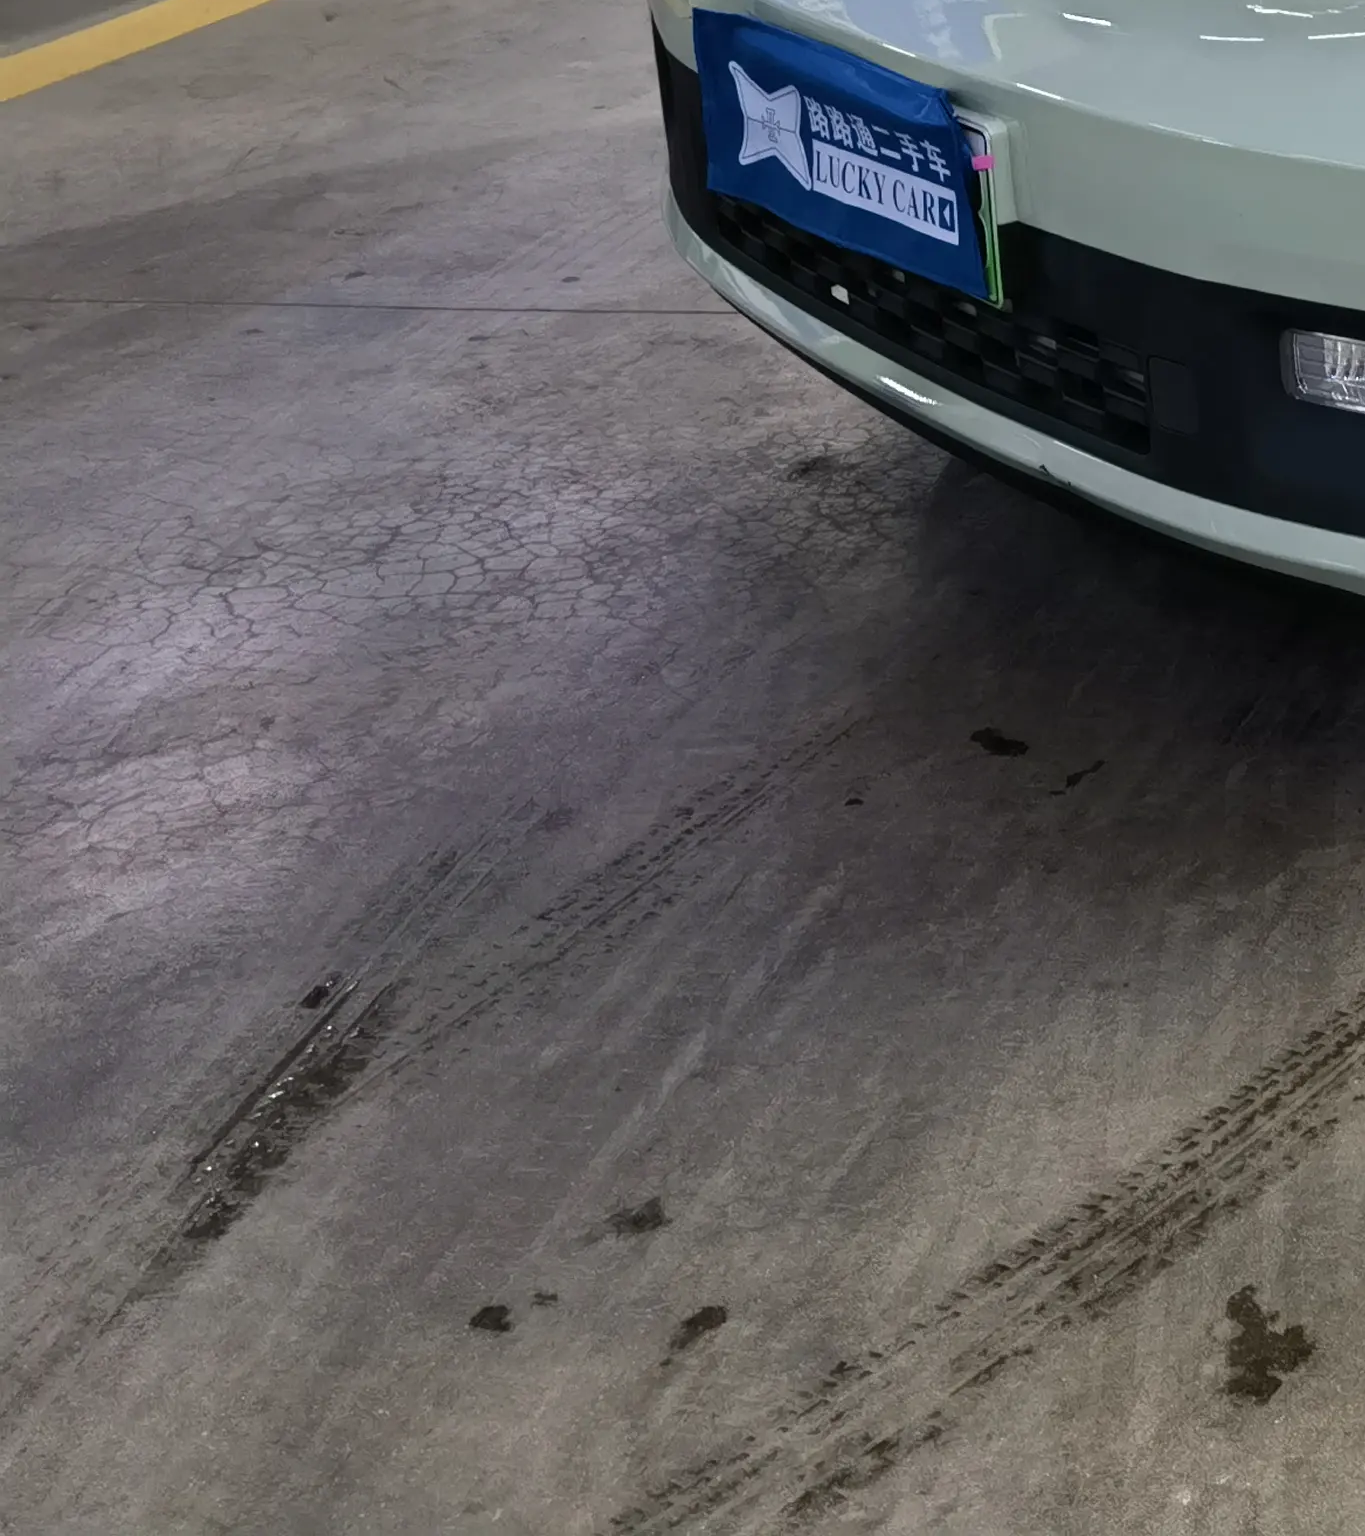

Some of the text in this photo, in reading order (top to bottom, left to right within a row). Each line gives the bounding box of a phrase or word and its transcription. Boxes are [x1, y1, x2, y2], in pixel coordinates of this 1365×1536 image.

[803, 95, 952, 182] 路路通二手车
[815, 149, 938, 227] LUCKY CAR
